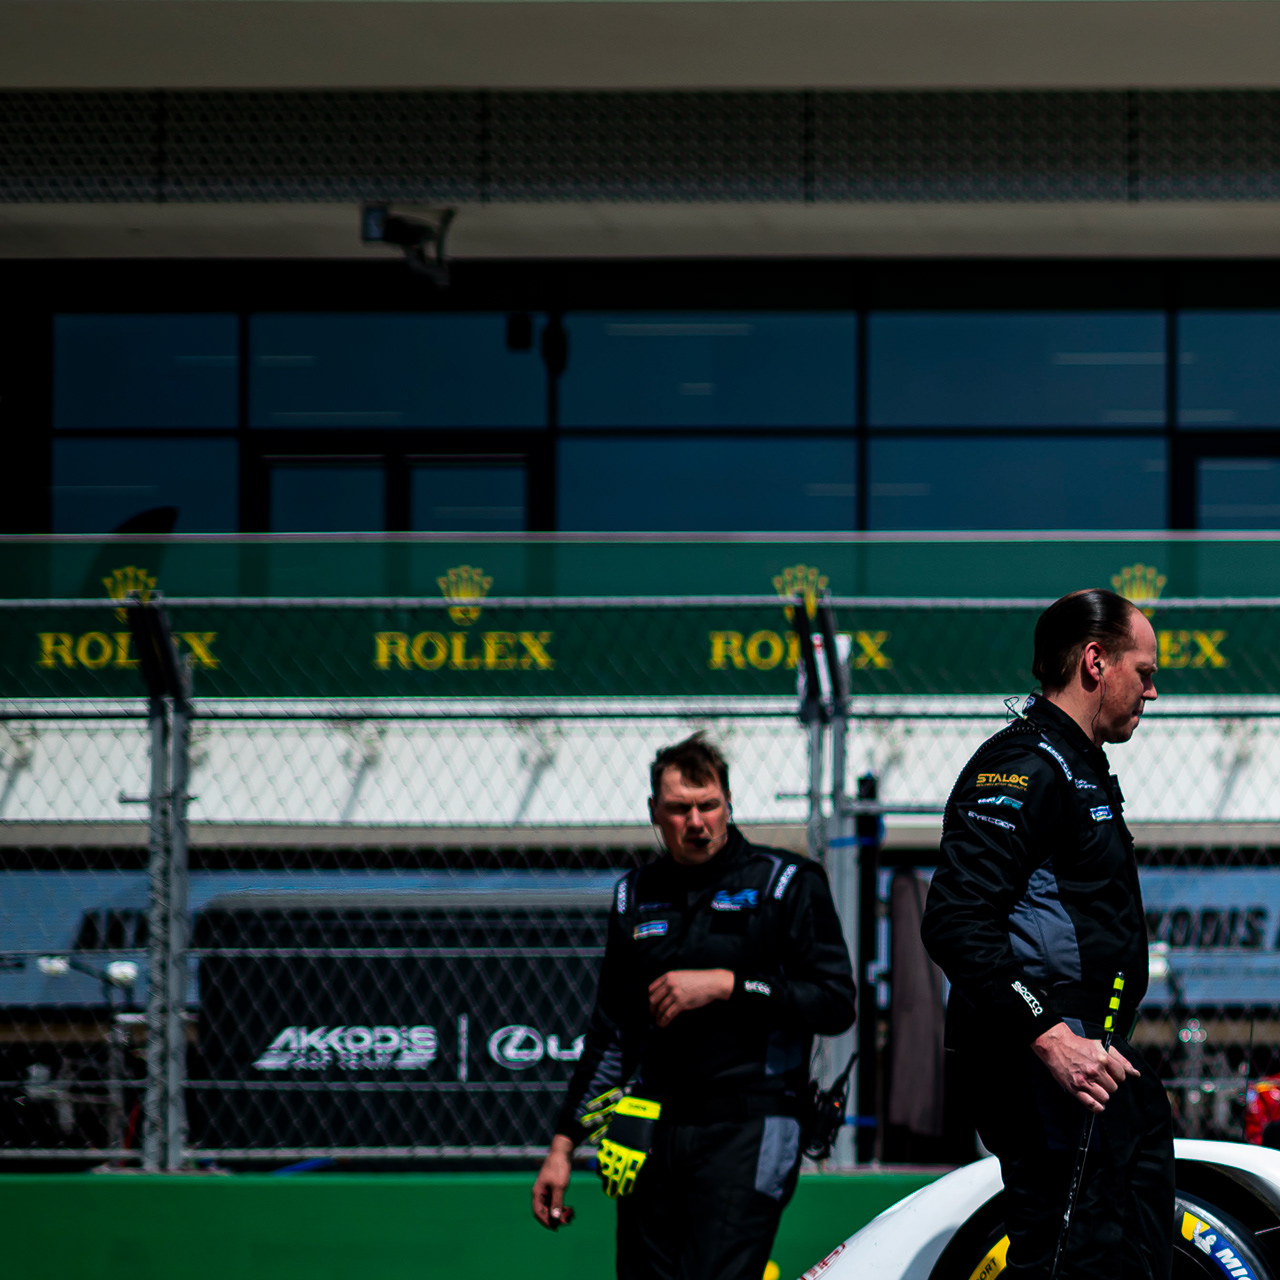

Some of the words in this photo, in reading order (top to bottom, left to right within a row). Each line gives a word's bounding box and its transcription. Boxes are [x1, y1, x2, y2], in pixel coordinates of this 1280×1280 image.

[37, 631, 221, 670] ROLX
[374, 631, 556, 670] ROLEX
[708, 630, 893, 670] ROX
[976, 773, 1029, 787] STALOC
[1011, 980, 1043, 1017] sparco
